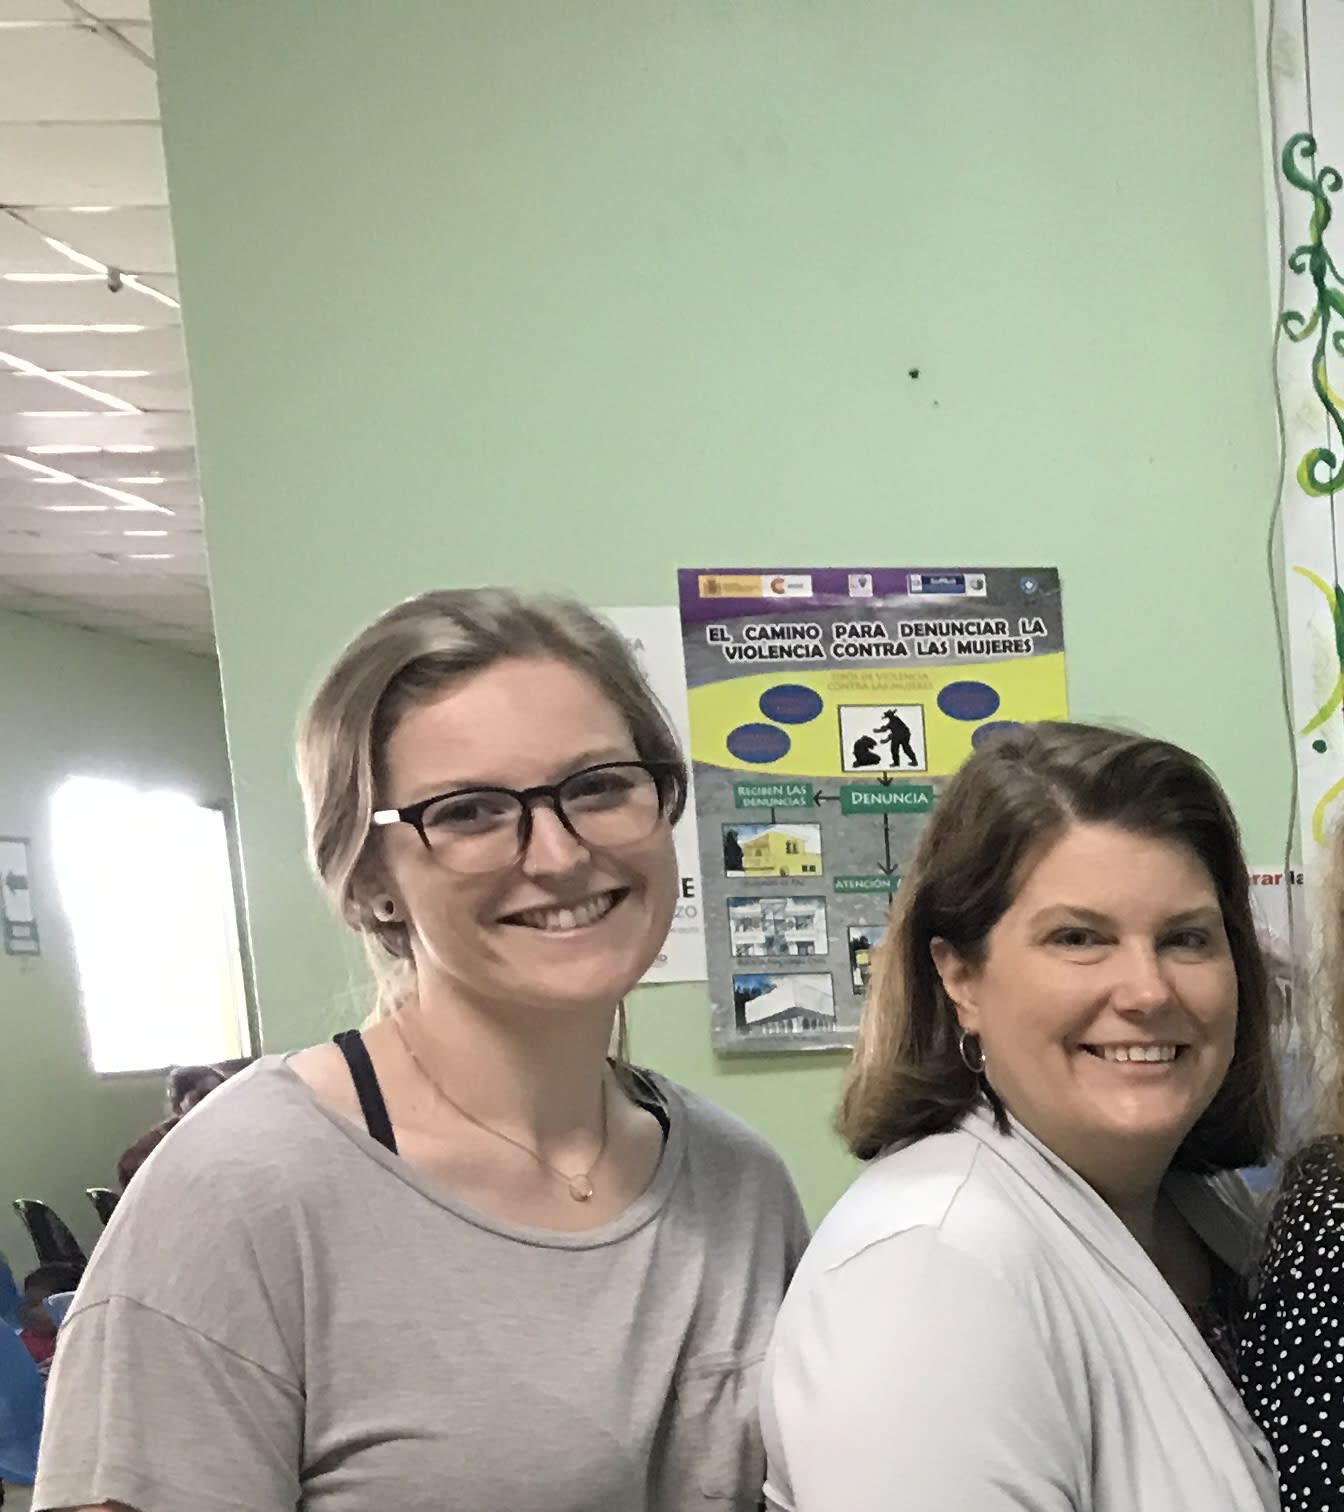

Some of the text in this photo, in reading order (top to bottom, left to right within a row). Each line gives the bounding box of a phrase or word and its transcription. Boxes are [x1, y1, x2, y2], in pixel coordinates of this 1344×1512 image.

[708, 617, 1047, 643] EL CAMINO PARA DENUNCIAR LA
[725, 638, 1032, 660] VIOLENCIA CONTRA LAS MUJERES
[851, 792, 929, 805] DENUNCIA
[835, 878, 891, 889] ATENCIÓN
